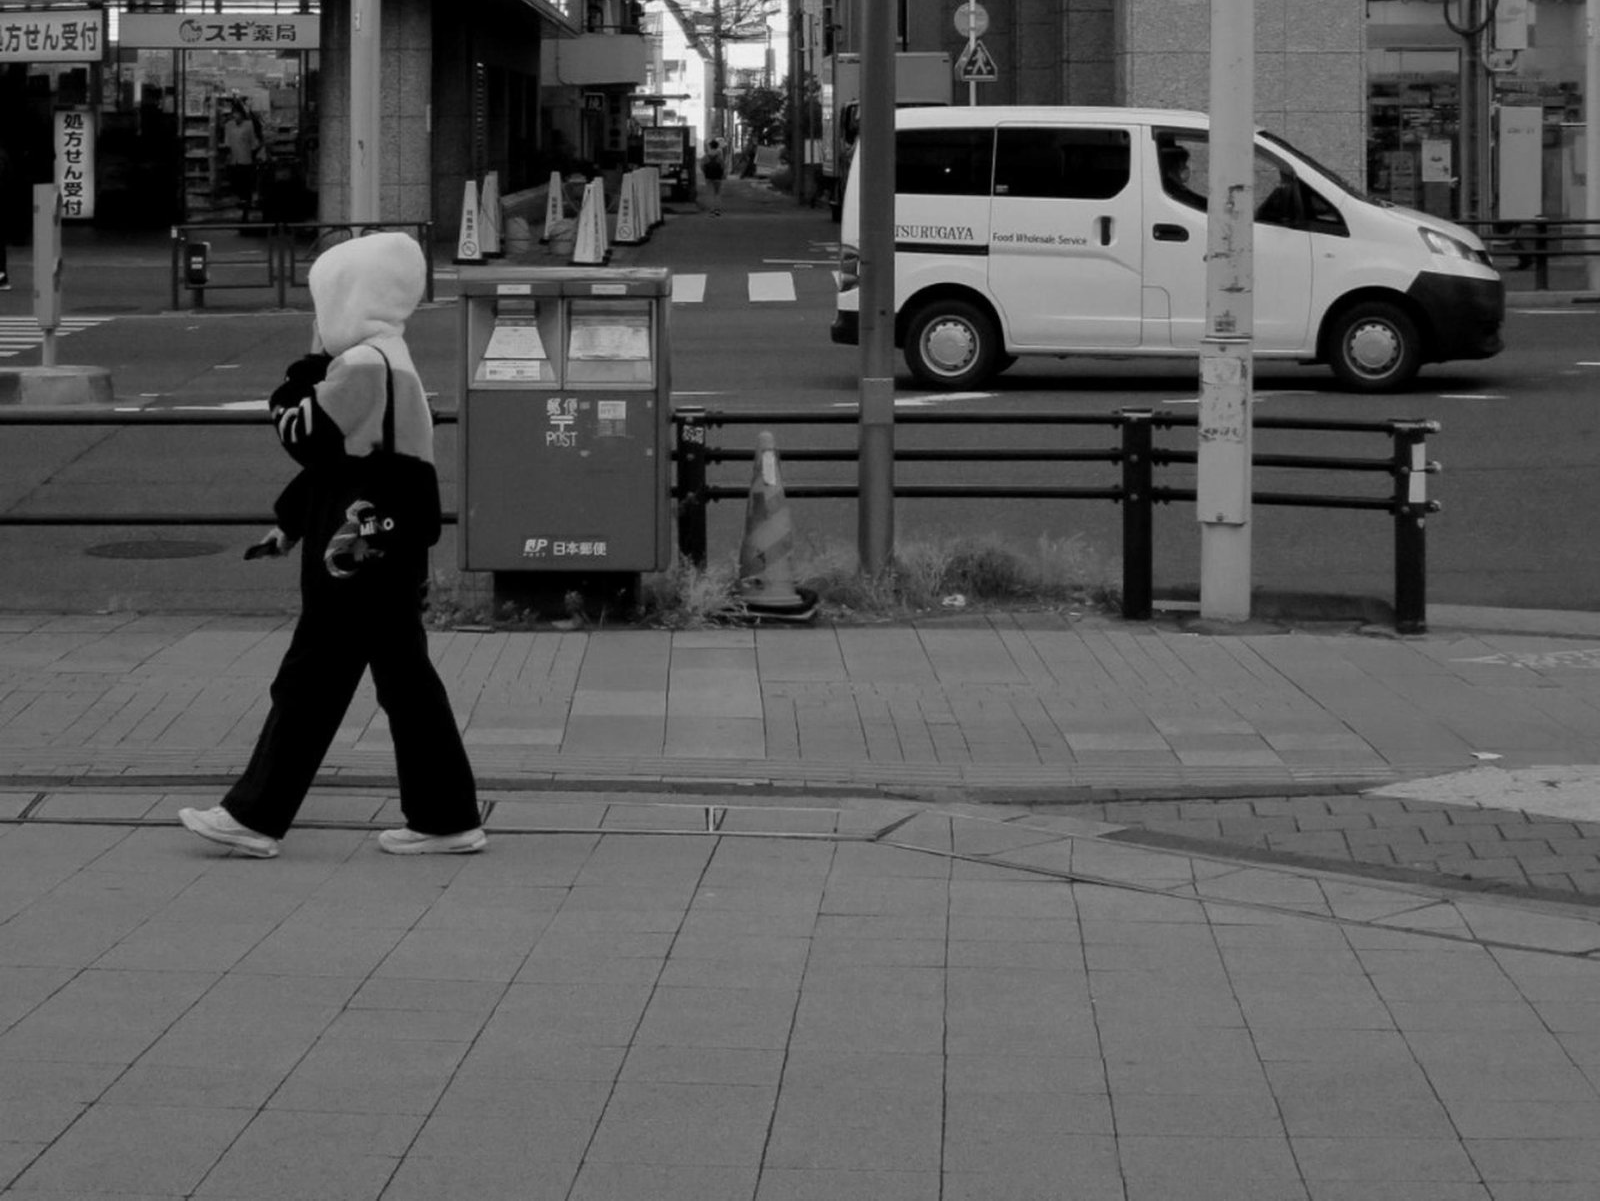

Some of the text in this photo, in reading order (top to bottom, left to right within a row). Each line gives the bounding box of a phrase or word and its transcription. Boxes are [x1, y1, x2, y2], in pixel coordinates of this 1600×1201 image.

[0, 21, 98, 52] 方せん受付
[205, 21, 296, 42] スギ薬局
[63, 113, 84, 216] 処方せん受付
[992, 232, 1014, 242] Food
[1058, 235, 1087, 246] Service
[546, 431, 578, 447] POST
[553, 541, 607, 556] 日本郵便
